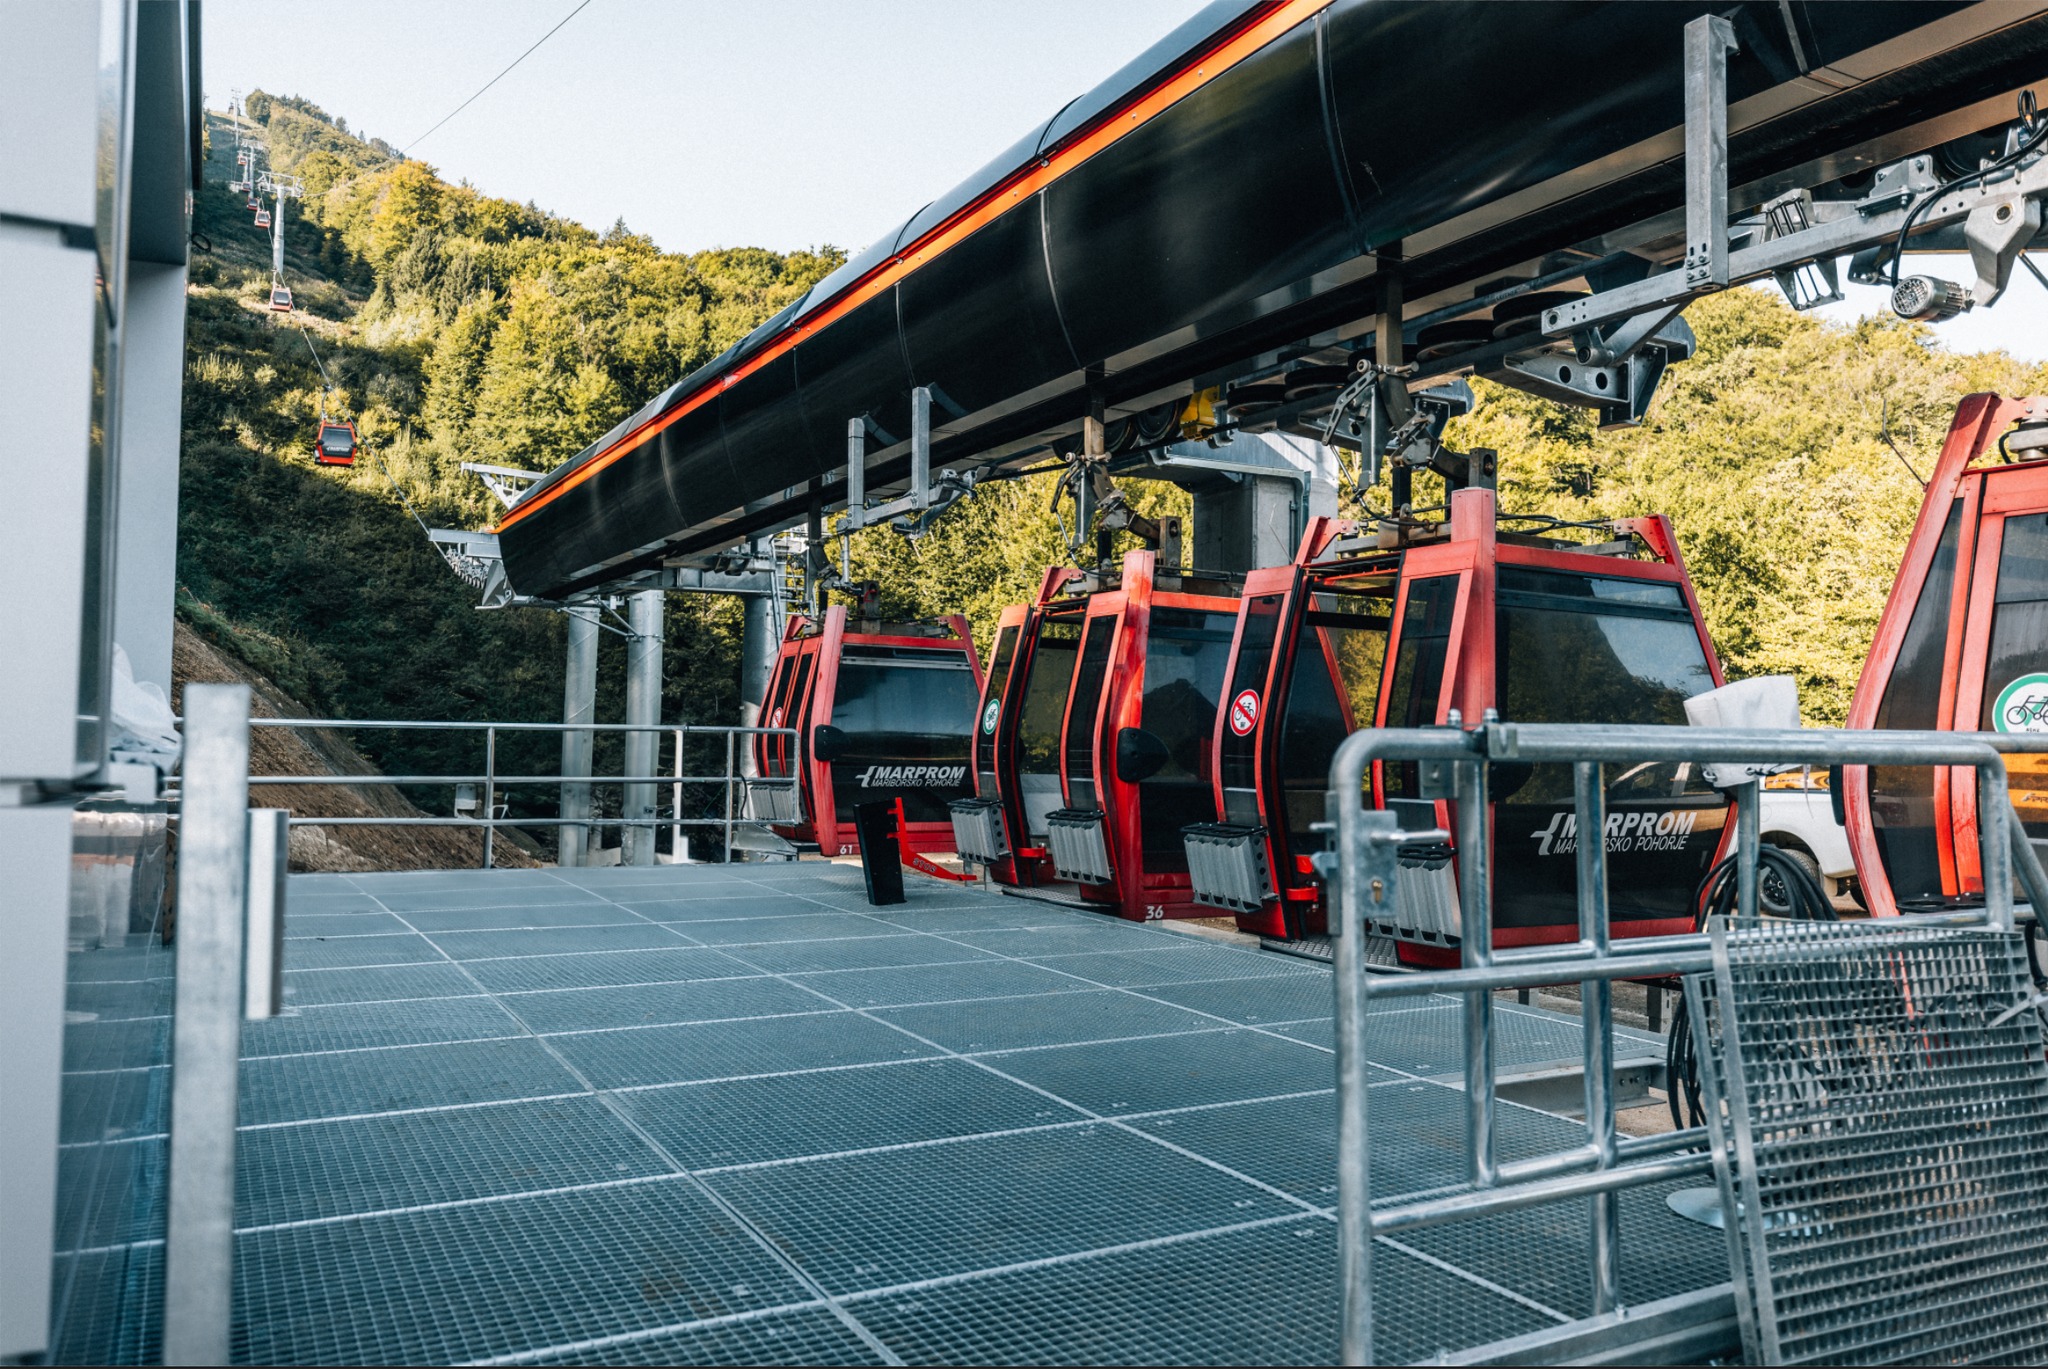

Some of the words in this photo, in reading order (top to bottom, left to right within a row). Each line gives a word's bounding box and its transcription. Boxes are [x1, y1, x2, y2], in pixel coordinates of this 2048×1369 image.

[874, 766, 966, 779] MARPROM
[871, 779, 922, 787] MARIBORSKO
[924, 778, 960, 787] POHORJE
[1560, 811, 1697, 838] MRPROM
[840, 845, 852, 855] 61
[1634, 835, 1689, 851] POHORJE
[1145, 905, 1164, 920] 36
